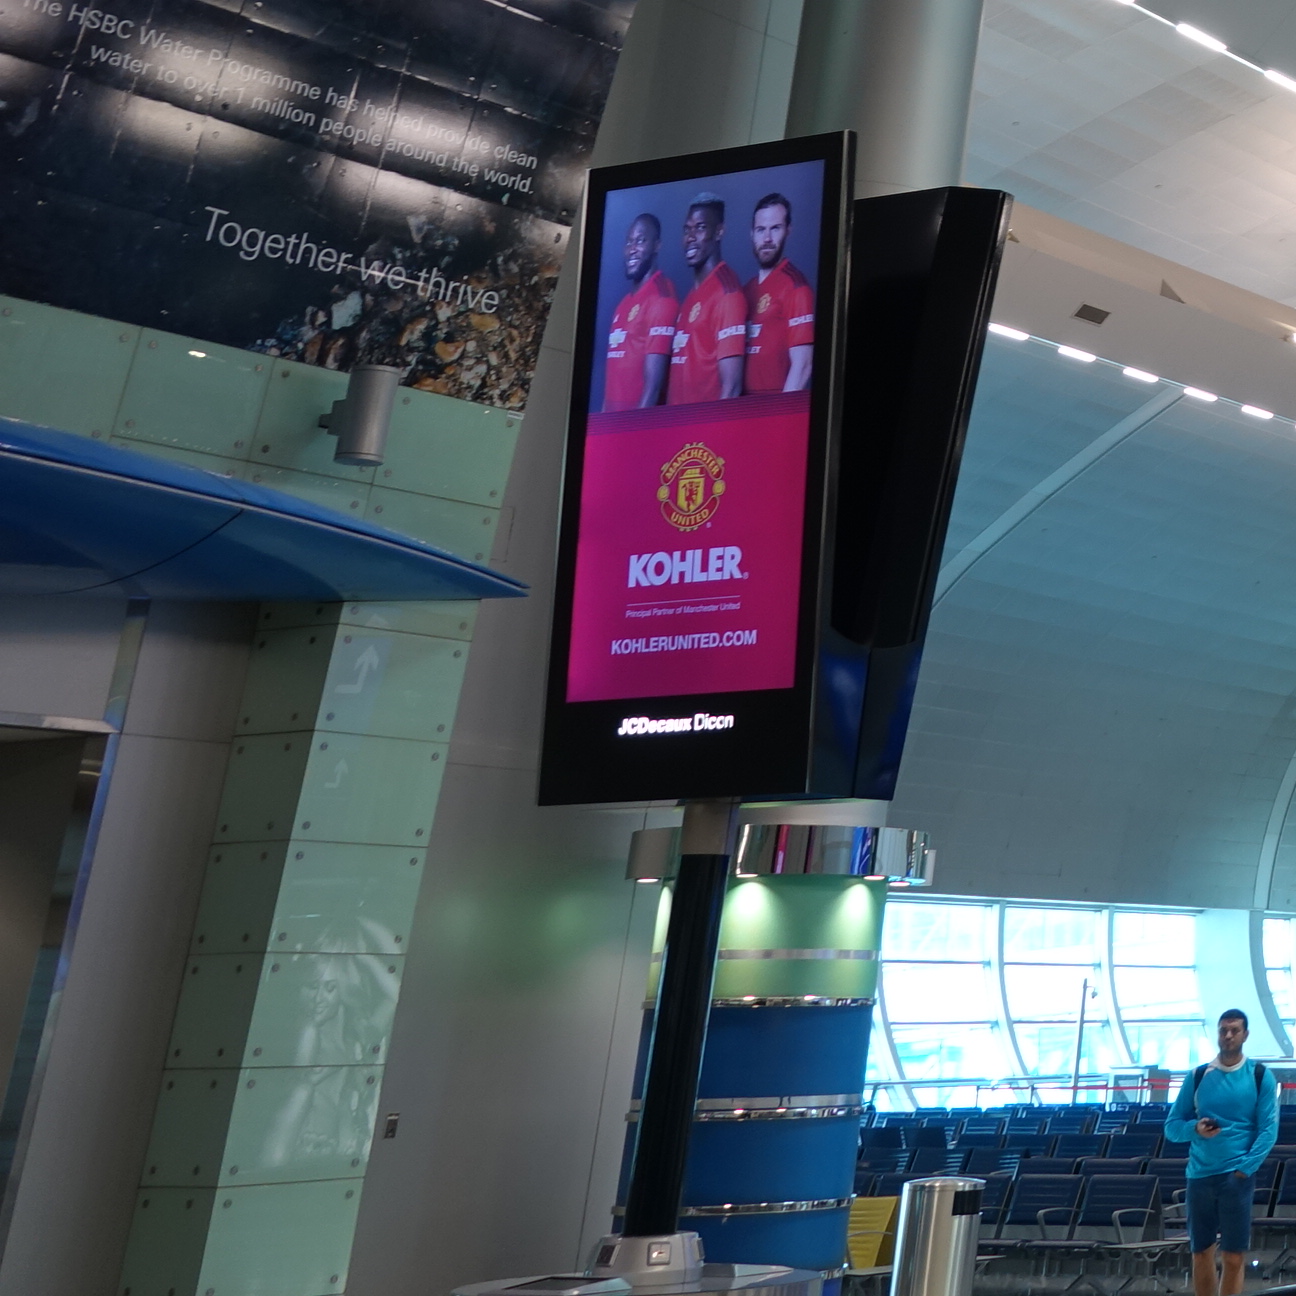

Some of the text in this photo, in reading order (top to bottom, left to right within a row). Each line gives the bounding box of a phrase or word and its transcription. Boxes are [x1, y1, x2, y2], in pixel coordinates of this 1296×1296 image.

[67, 3, 135, 40] HSBC
[139, 25, 204, 63] Water
[207, 48, 321, 101] Programme
[324, 86, 359, 111] has
[363, 98, 425, 133] helped
[426, 120, 492, 154] provide
[494, 144, 539, 171] clean
[90, 44, 536, 196] water to over 1 million people around the world.
[204, 205, 500, 314] Together we thrive
[665, 449, 720, 479] MANCHESTER
[670, 508, 709, 526] UNITED
[628, 546, 743, 588] KOHLER
[611, 629, 757, 655] KOHLERUNITED.COM
[617, 716, 693, 736] JCDecaux
